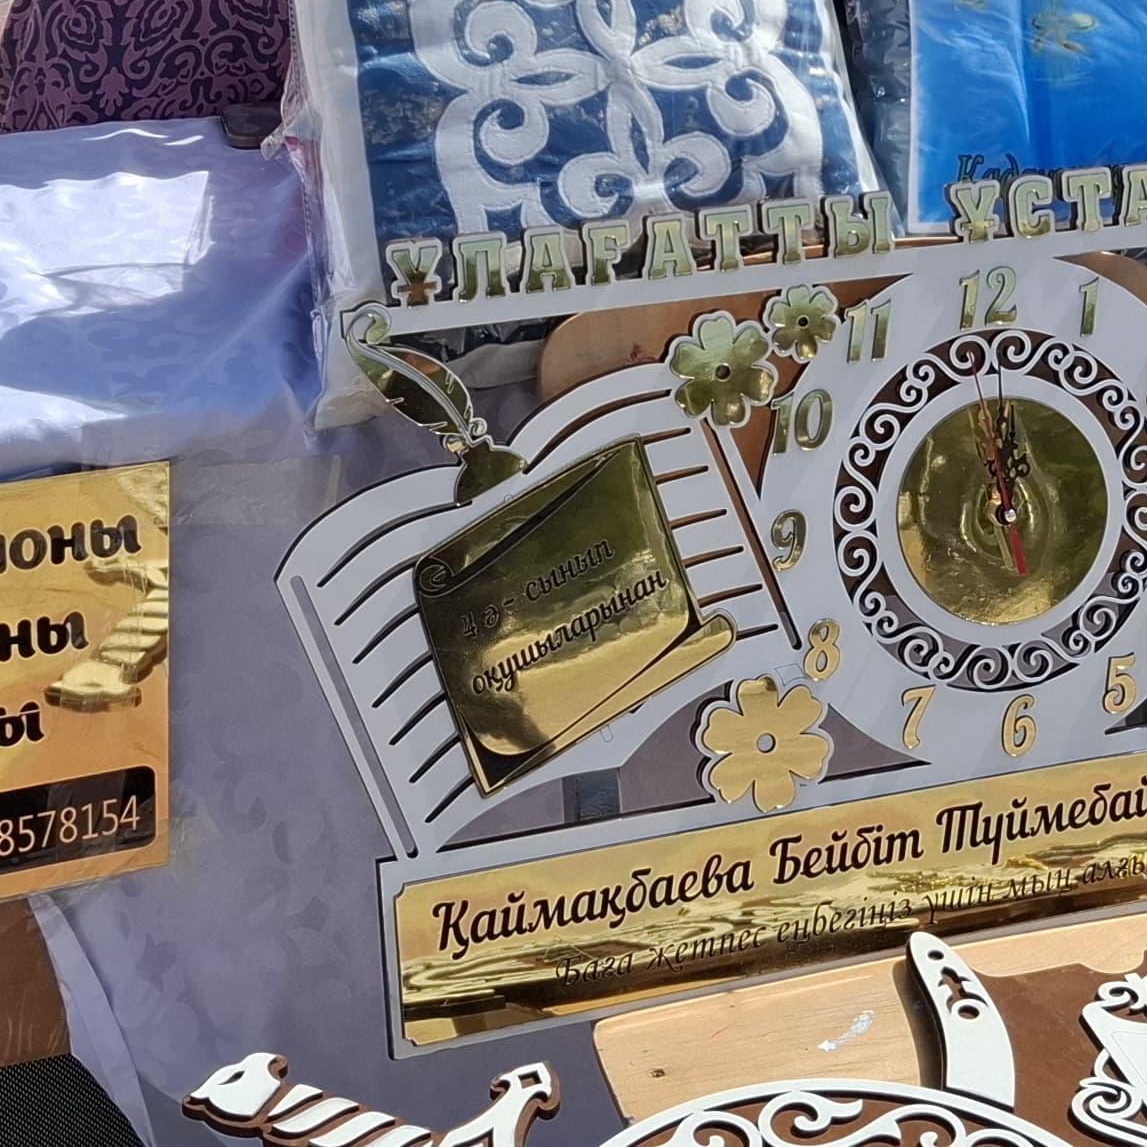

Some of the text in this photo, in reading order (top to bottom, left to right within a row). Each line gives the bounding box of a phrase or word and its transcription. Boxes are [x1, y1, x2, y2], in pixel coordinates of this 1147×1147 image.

[388, 194, 892, 306] ҰЛАҒАТТЫ
[959, 266, 1017, 330] 12
[1079, 278, 1100, 338] 1
[846, 299, 892, 363] 11
[772, 388, 832, 455] 10
[525, 540, 614, 602] сынып
[770, 510, 807, 571] 9
[472, 571, 667, 695] оқушыларынан
[804, 619, 841, 681] 8
[1103, 653, 1136, 714] 5
[902, 685, 936, 749] 7
[1002, 694, 1037, 757] 6
[432, 854, 754, 960] Қаймақбаева
[770, 823, 923, 884] Бейбіт
[646, 925, 766, 973] жетпес
